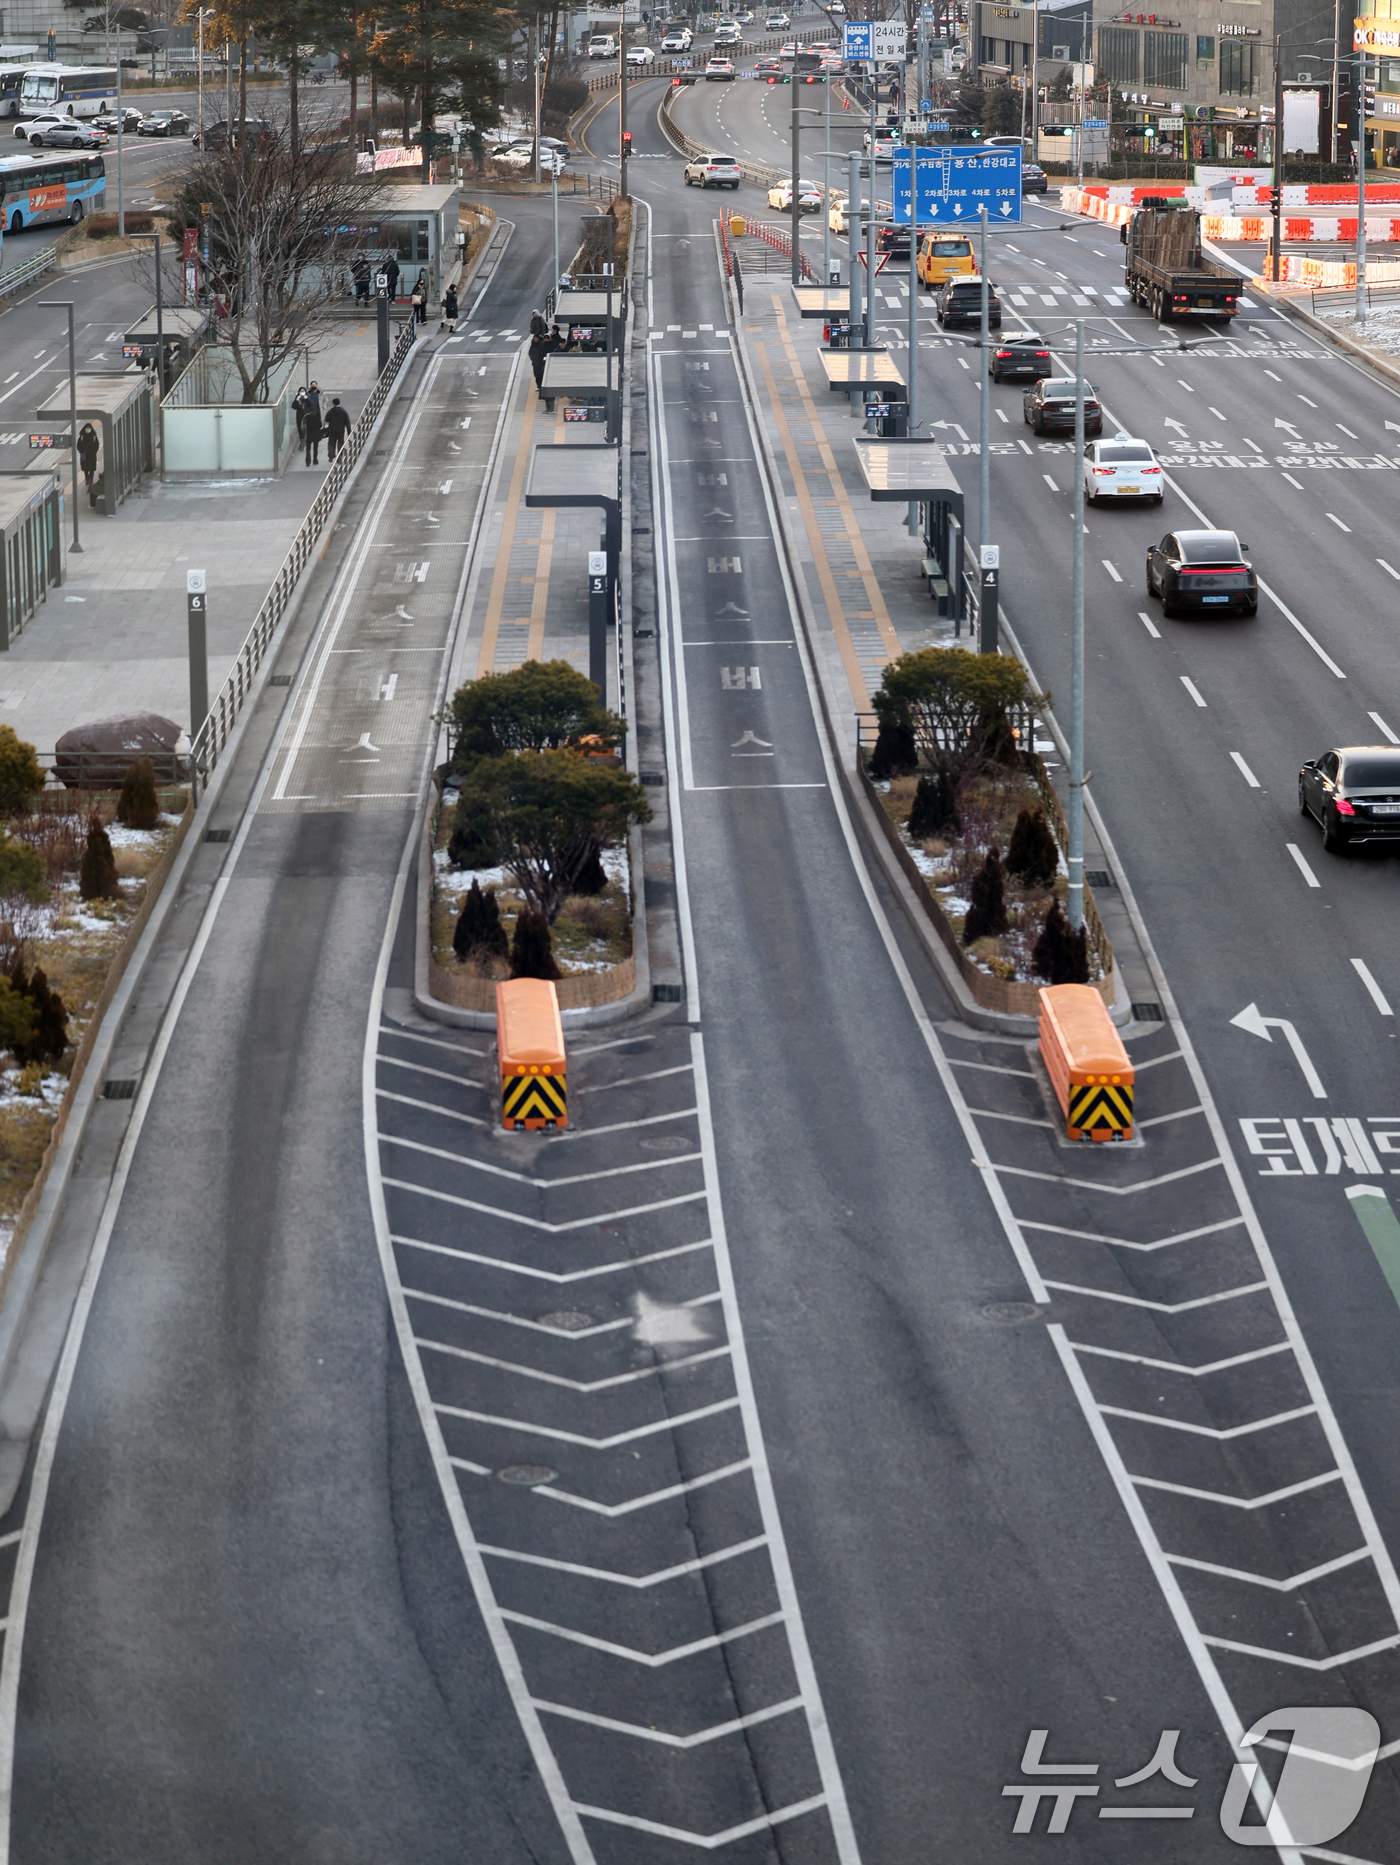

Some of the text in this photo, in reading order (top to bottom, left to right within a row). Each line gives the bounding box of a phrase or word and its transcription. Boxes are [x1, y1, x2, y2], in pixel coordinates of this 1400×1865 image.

[875, 26, 905, 37] 24시간
[1354, 28, 1369, 44] OK
[925, 189, 944, 197] 2차로
[948, 189, 967, 197] 3차로
[971, 189, 991, 197] 4차로
[995, 188, 1017, 197] 5차로
[1167, 440, 1228, 453] 용산
[1282, 441, 1344, 454] 용산
[1157, 455, 1273, 468] 한강대교
[985, 572, 995, 583] 4
[593, 578, 602, 590] 5
[192, 596, 201, 608] 6
